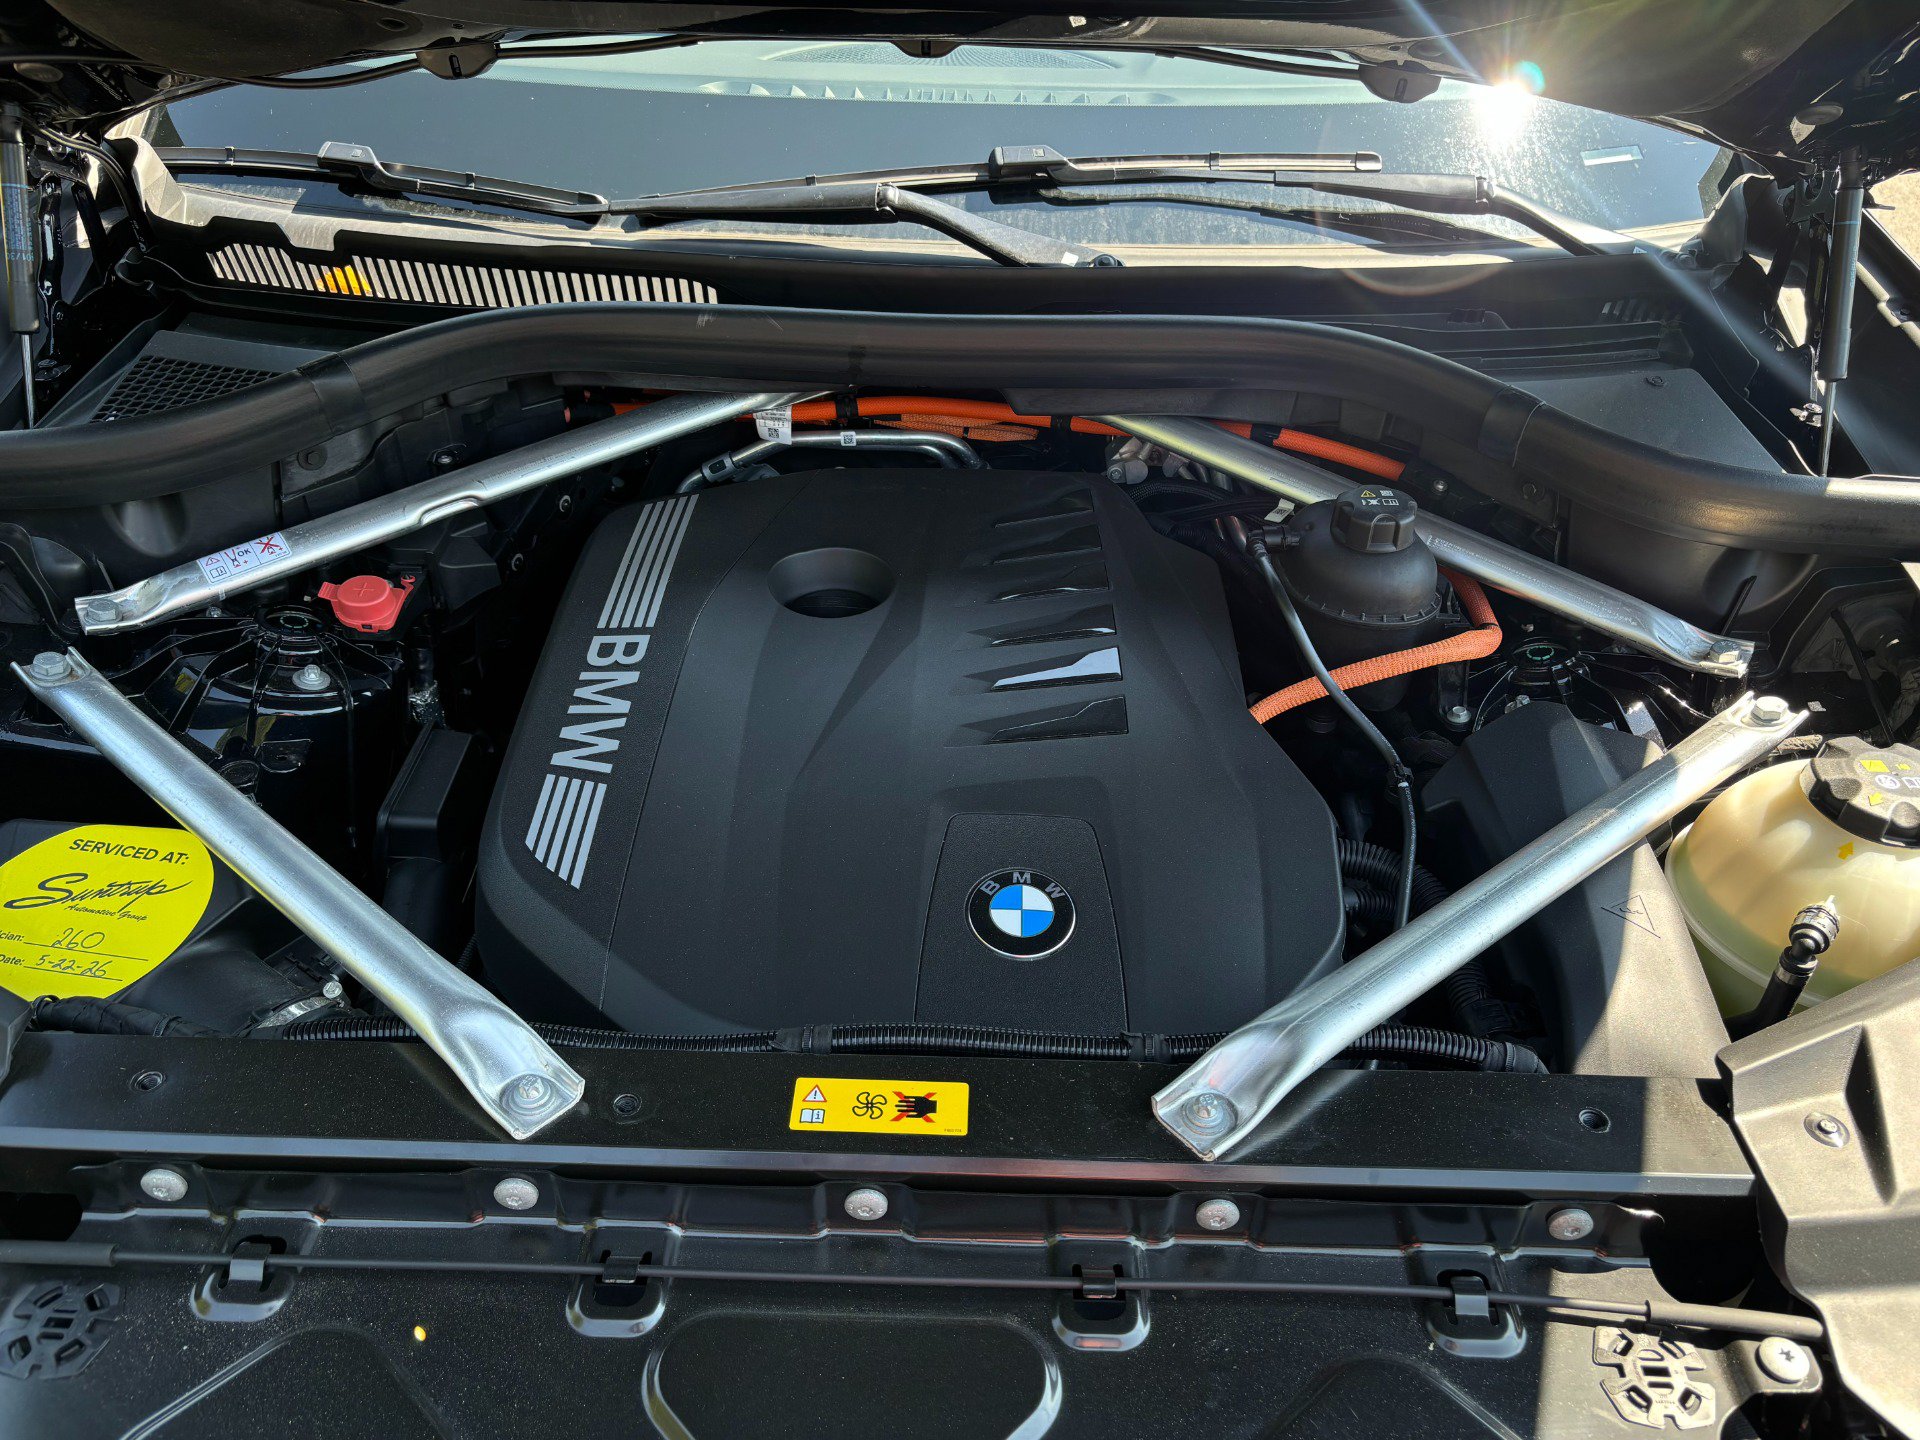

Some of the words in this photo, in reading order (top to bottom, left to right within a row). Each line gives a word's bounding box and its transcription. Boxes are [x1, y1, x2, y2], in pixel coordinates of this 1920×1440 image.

[237, 547, 252, 557] OK
[550, 634, 651, 774] BMW
[69, 838, 158, 861] SERVICED
[159, 852, 189, 865] AT:
[980, 871, 1065, 899] BMW
[64, 903, 117, 917] Automotive
[119, 911, 149, 921] Group
[51, 927, 106, 949] 260
[35, 954, 112, 978] 5-22-26
